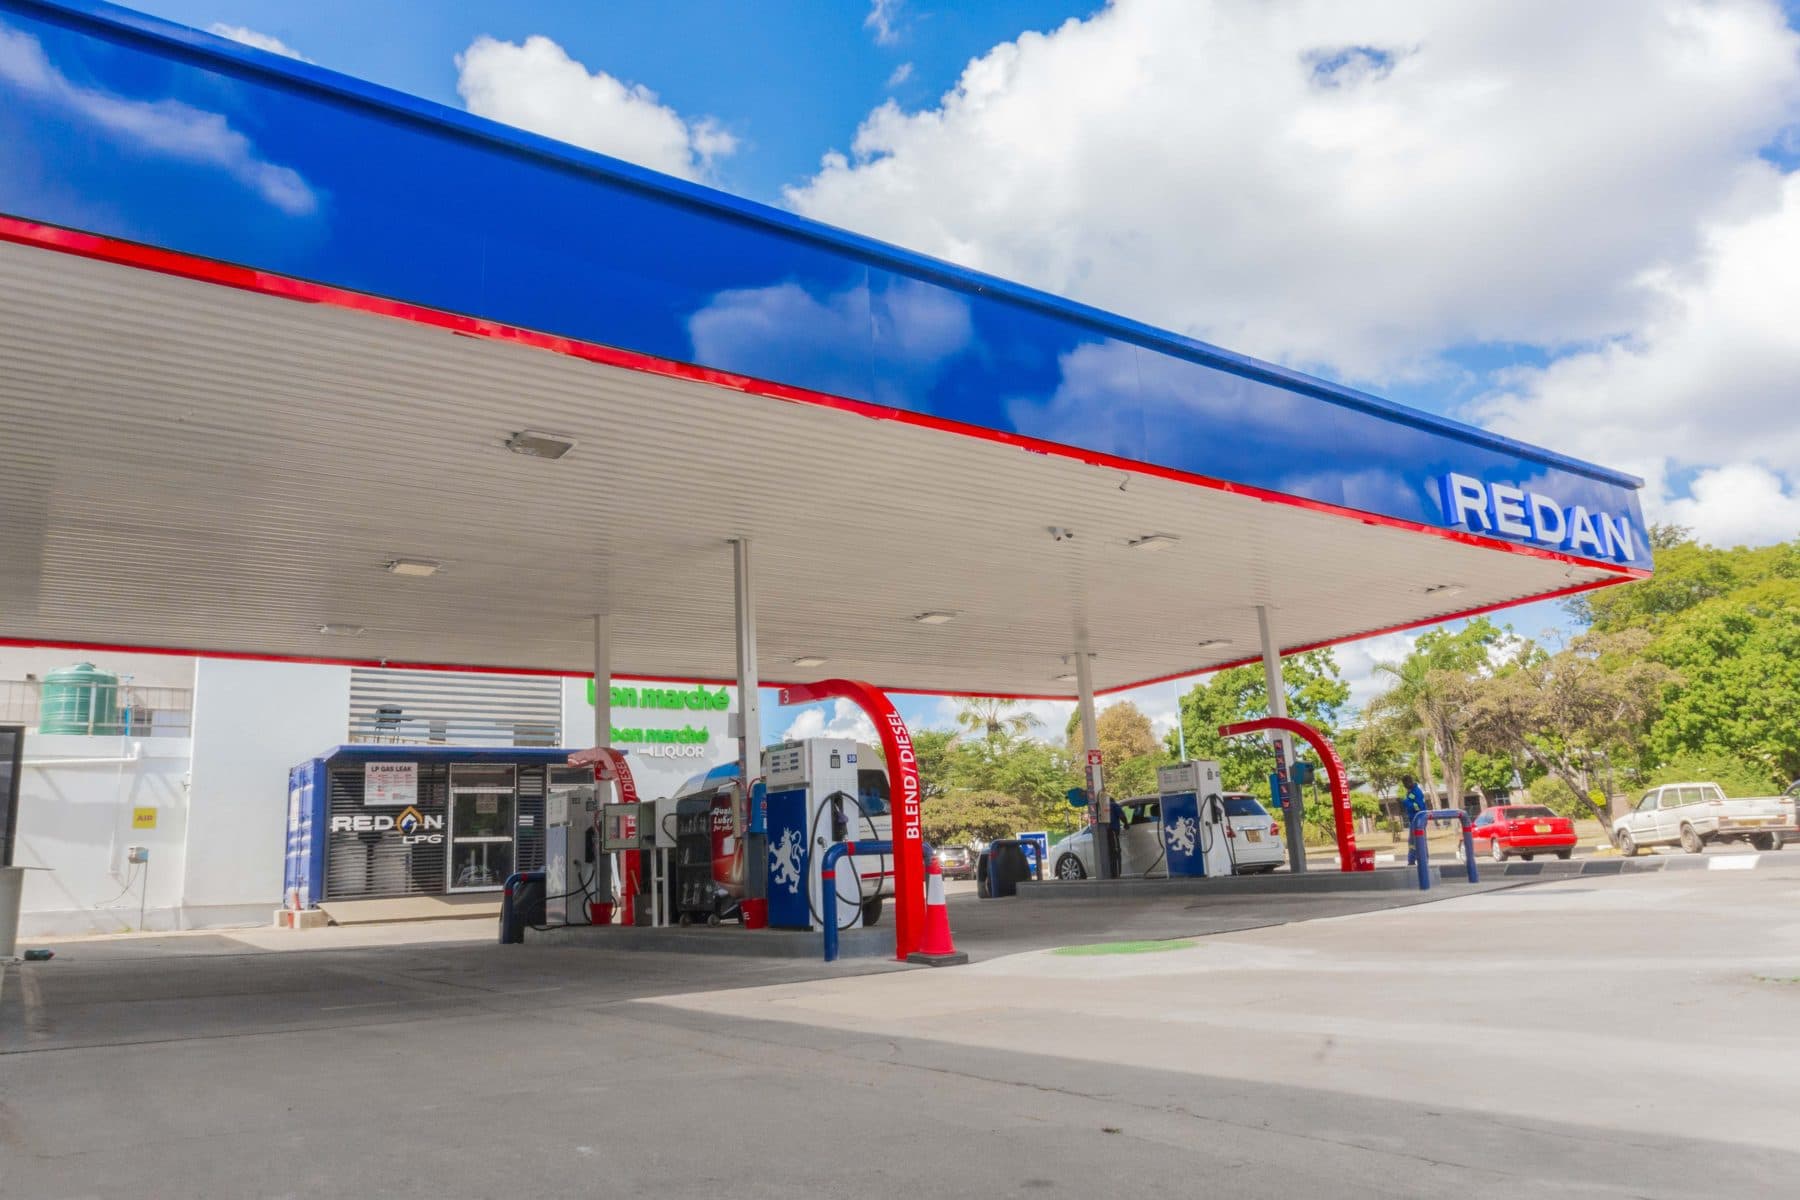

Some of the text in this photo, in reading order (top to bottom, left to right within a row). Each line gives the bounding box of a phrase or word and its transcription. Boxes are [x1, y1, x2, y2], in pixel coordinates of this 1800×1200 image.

[1449, 471, 1636, 561] REDAN
[640, 685, 730, 710] marché
[783, 690, 790, 704] 3
[645, 724, 709, 744] marché
[886, 710, 914, 763] DIESEL
[654, 744, 705, 758] LIQUOR
[903, 775, 920, 839] BLEND
[403, 834, 443, 844] LPG
